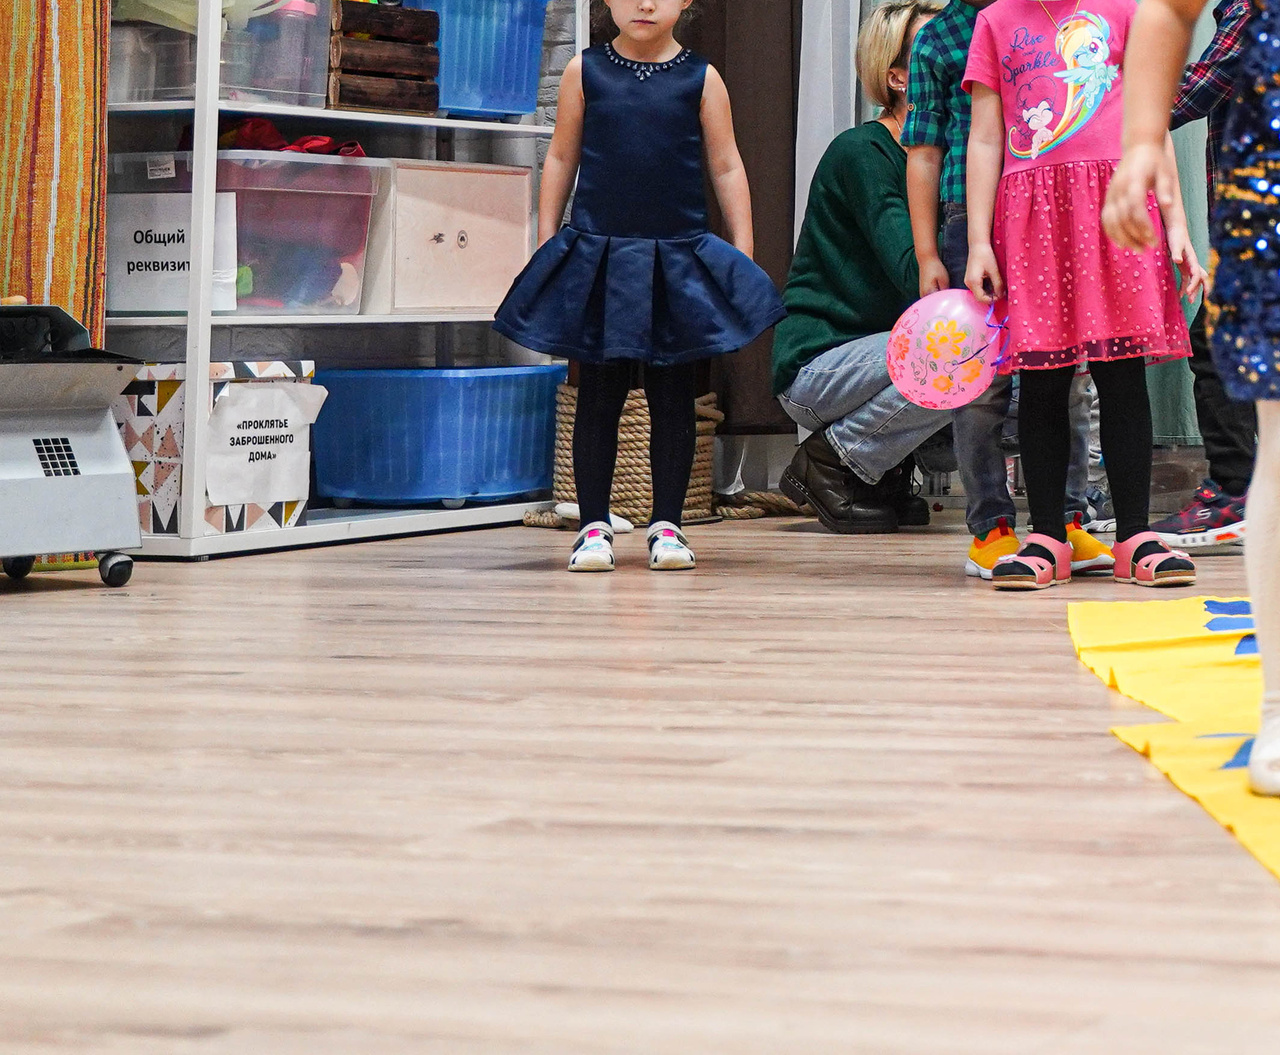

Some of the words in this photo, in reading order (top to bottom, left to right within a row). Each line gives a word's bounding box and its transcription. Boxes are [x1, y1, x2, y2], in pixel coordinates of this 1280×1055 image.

[1009, 26, 1046, 52] Rise
[1001, 50, 1060, 86] Sparkle
[133, 229, 185, 247] Общий
[236, 418, 289, 430] «ПРОКЛЯТЬЕ
[229, 433, 294, 447] ЗАБРОШЕННОГО
[248, 450, 277, 463] ДОМА»
